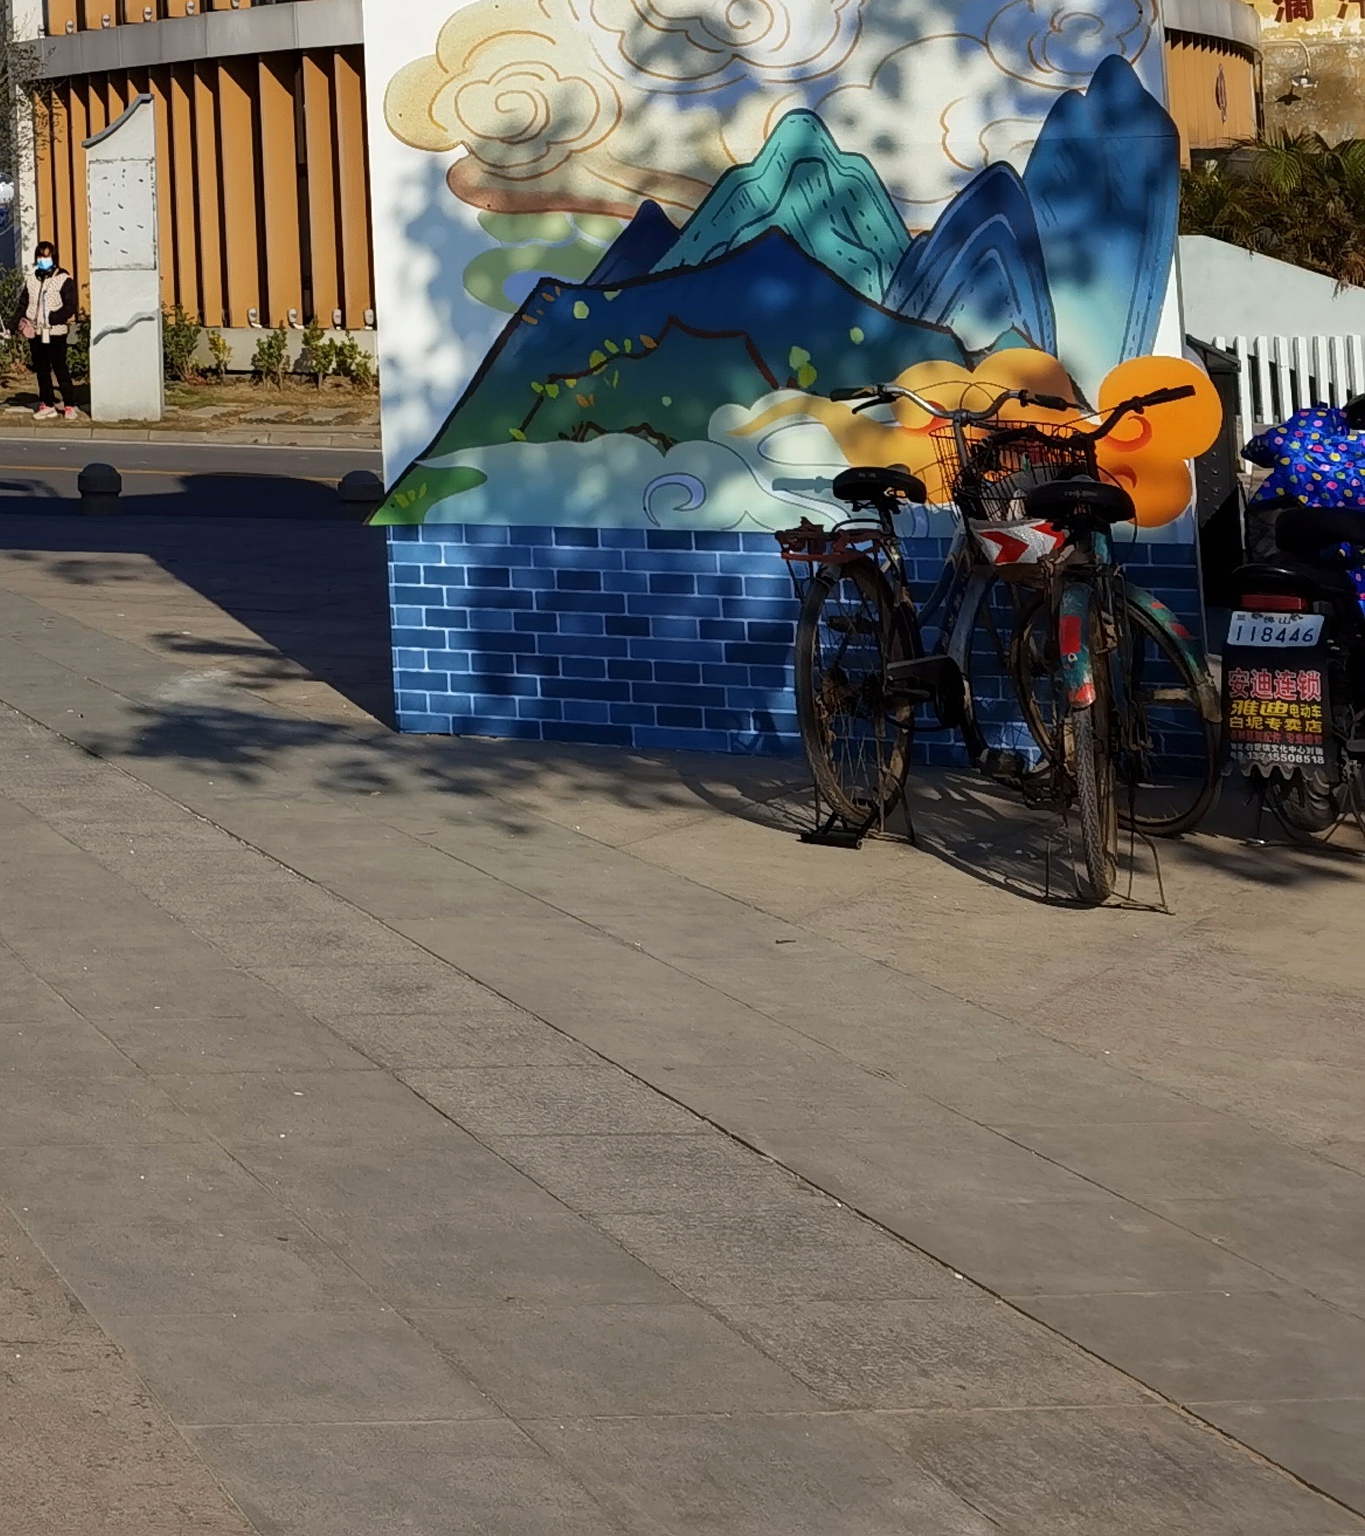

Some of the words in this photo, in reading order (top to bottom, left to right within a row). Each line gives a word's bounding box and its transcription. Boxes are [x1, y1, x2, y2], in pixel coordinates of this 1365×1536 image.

[1236, 625, 1314, 643] 118446
[1228, 667, 1322, 701] 安迪连锁
[1229, 717, 1323, 734] 白坭专卖店
